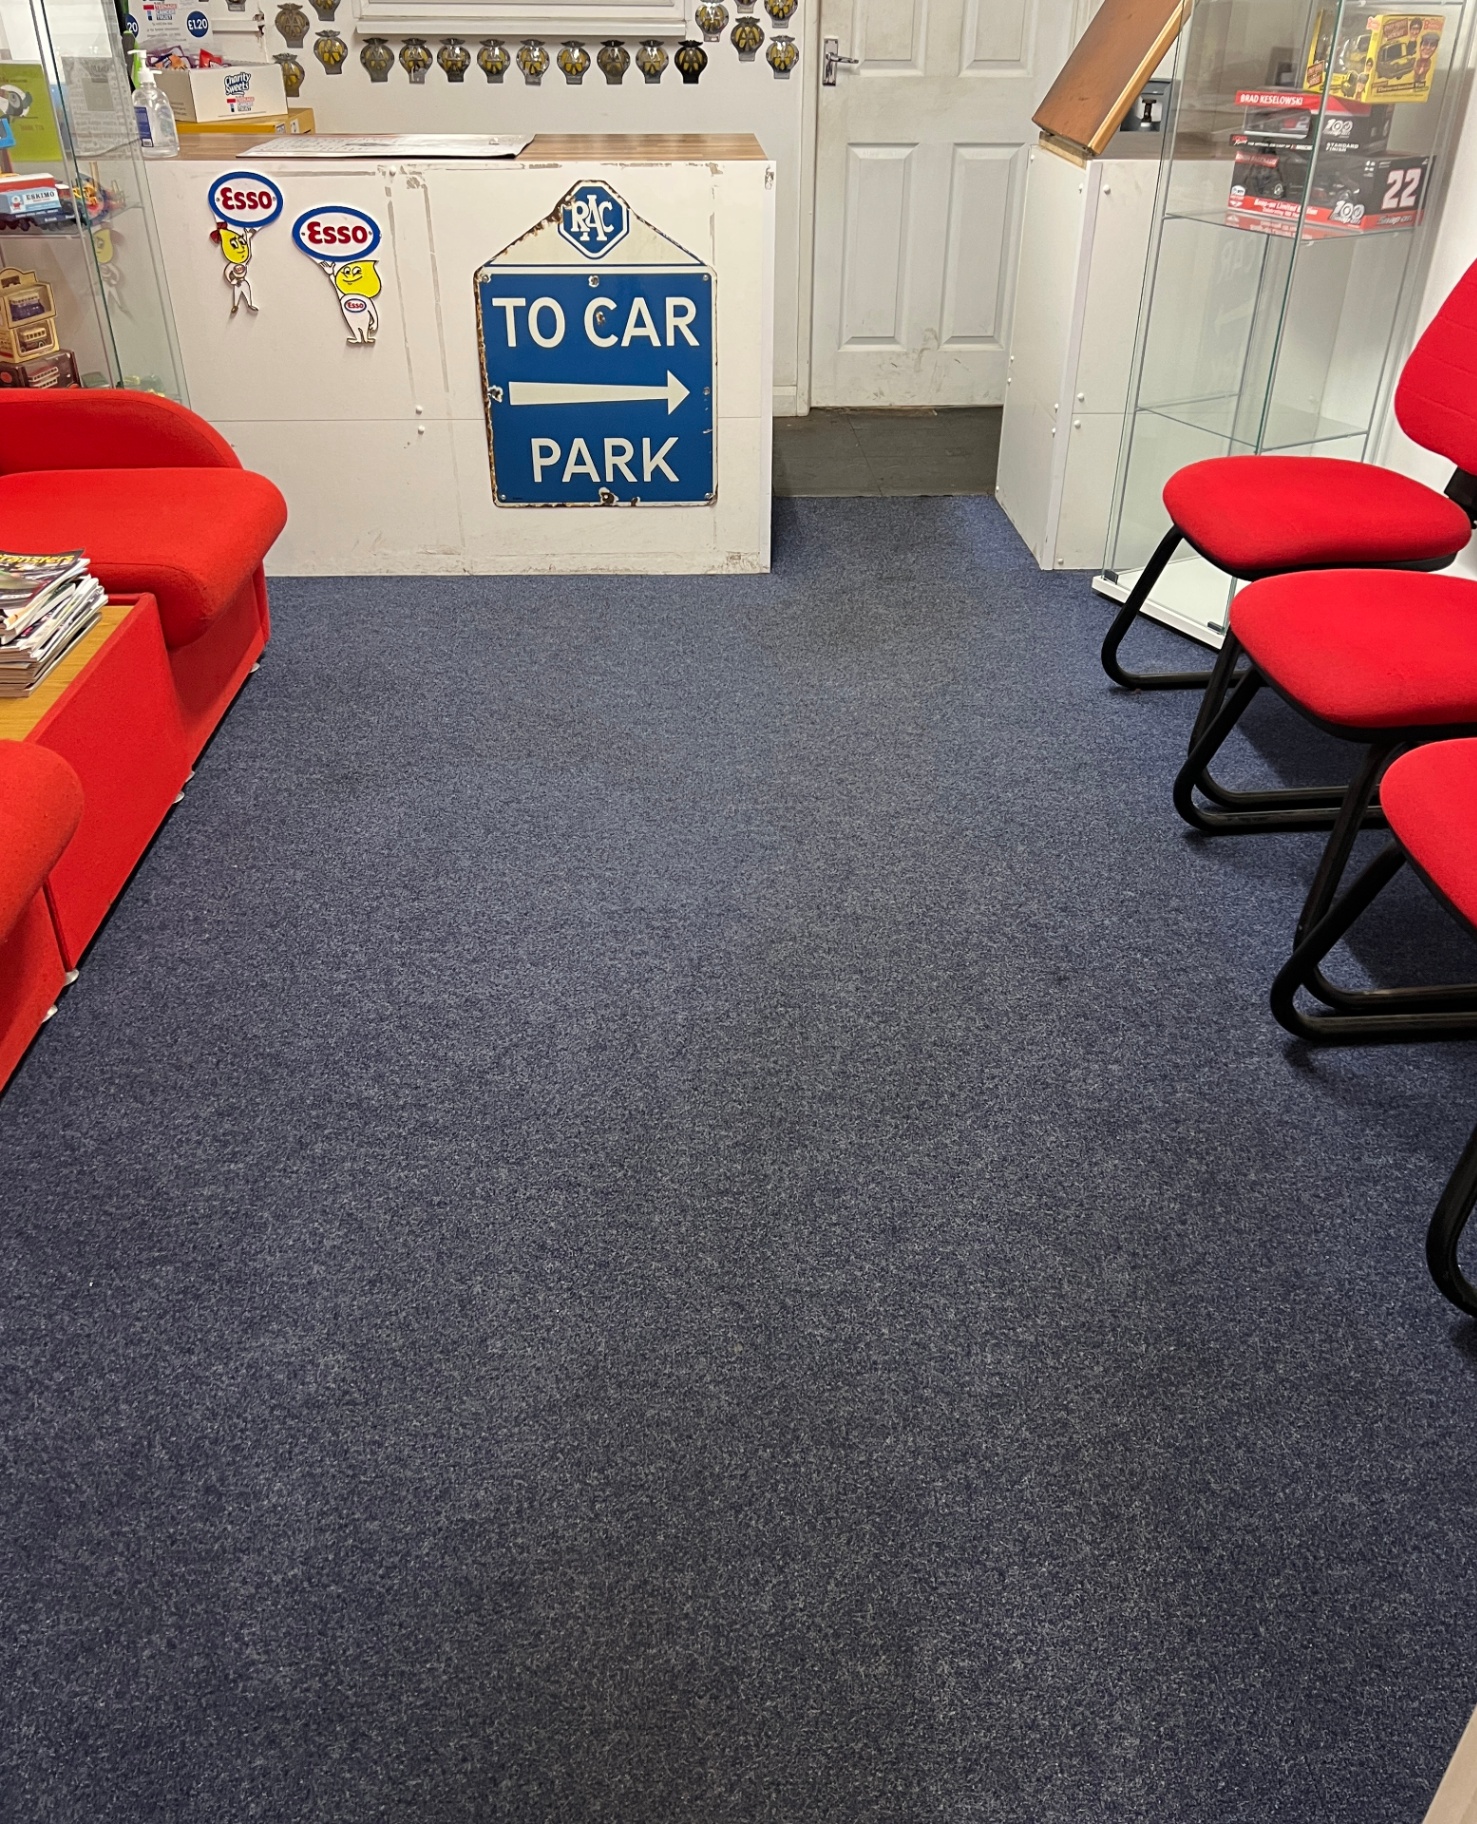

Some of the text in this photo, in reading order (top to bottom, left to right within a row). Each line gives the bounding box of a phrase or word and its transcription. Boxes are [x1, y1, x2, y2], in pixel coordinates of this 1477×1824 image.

[224, 72, 251, 87] Charity
[1240, 94, 1303, 105] BRAD KESELOWSKI
[26, 191, 55, 201] ESKIMO
[220, 187, 272, 210] Esso
[1381, 168, 1421, 210] 22
[570, 194, 614, 241] RAC
[306, 221, 368, 244] Esso
[491, 297, 700, 348] TO CAR
[531, 437, 680, 483] PARK
